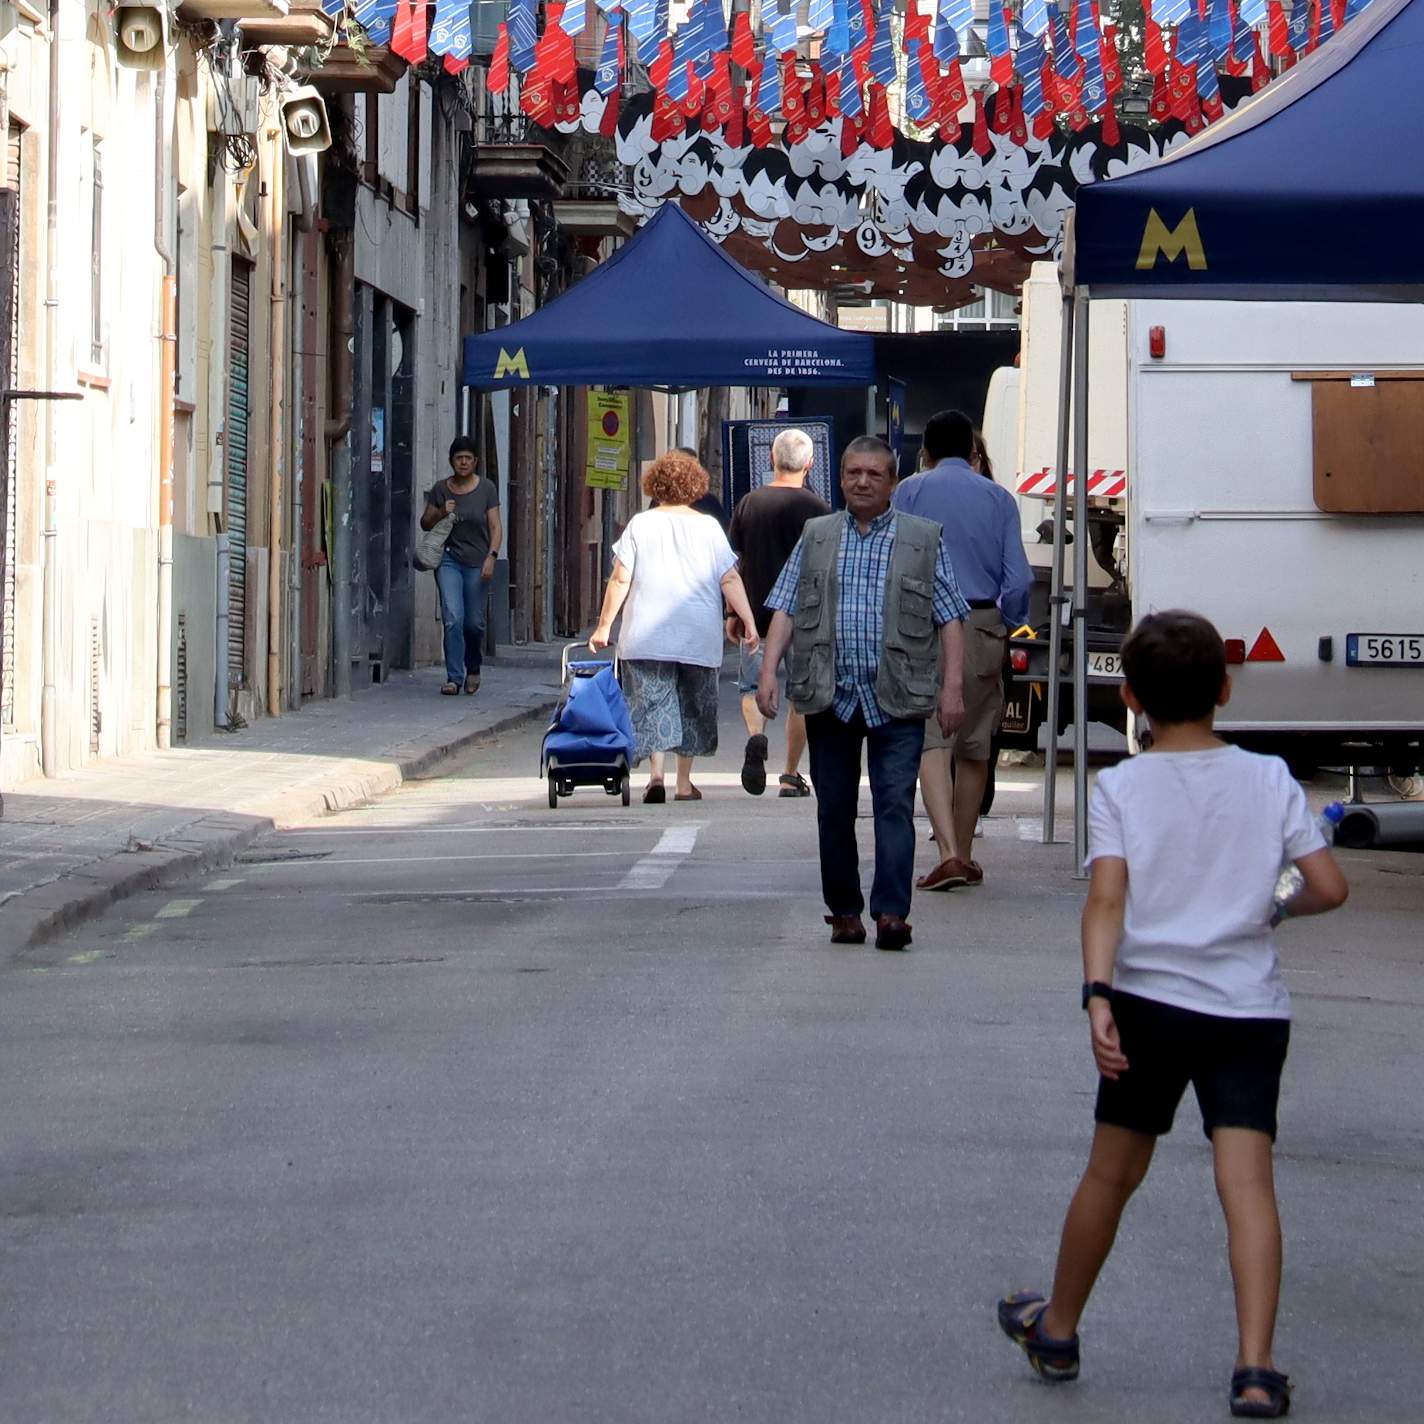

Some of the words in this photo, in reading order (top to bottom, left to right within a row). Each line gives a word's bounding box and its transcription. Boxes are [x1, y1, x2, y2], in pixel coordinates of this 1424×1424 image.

[1135, 207, 1208, 270] M
[768, 350, 778, 358] LA
[781, 350, 818, 358] PRIMERA
[493, 346, 531, 379] M
[744, 358, 779, 366] CERVESA
[795, 359, 845, 367] BARCELONA.
[767, 367, 782, 375] DES
[785, 367, 795, 375] DE
[1367, 639, 1421, 660] 5615
